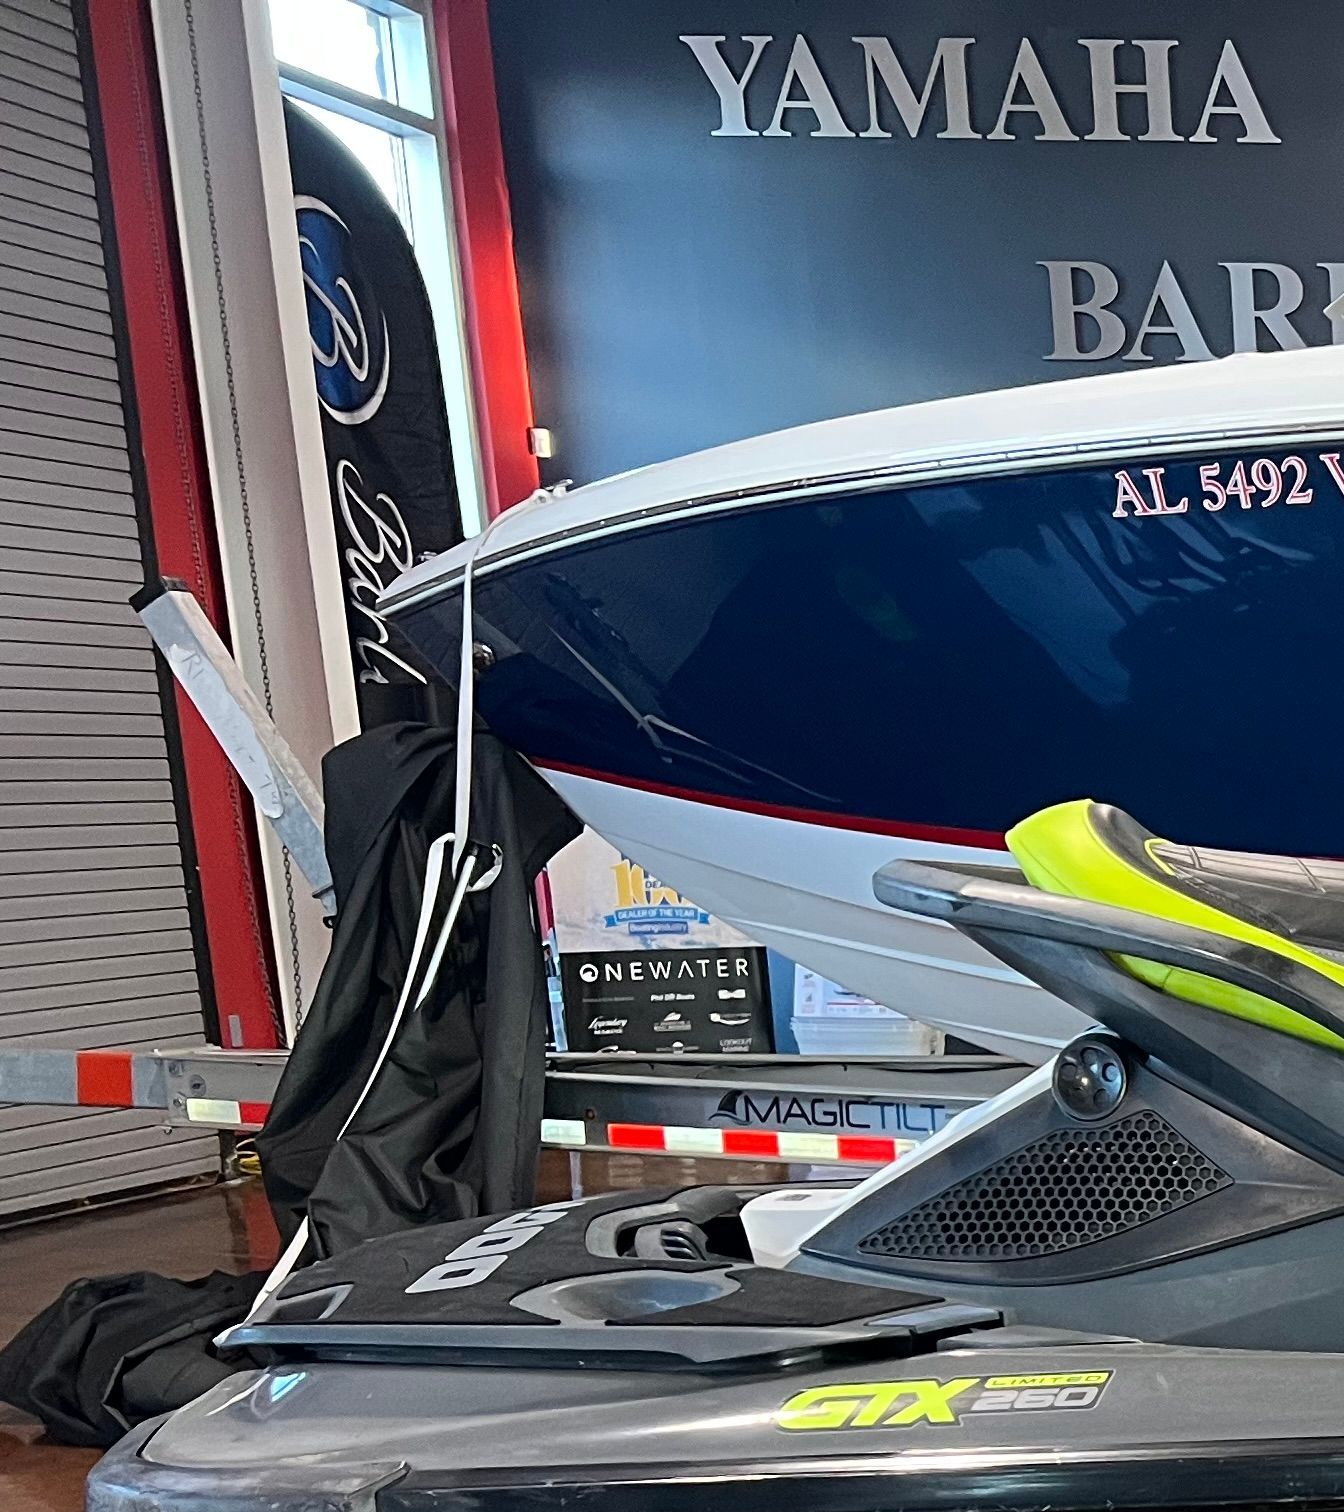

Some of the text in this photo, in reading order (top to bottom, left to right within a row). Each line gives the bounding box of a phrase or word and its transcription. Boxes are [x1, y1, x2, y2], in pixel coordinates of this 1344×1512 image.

[679, 34, 1282, 143] YAMAHA
[1112, 468, 1189, 518] AL
[1199, 455, 1312, 512] 5492
[743, 1095, 946, 1134] MAGICTILT
[777, 1374, 1104, 1429] GTX LIMITED
[970, 1386, 1100, 1412] 260
